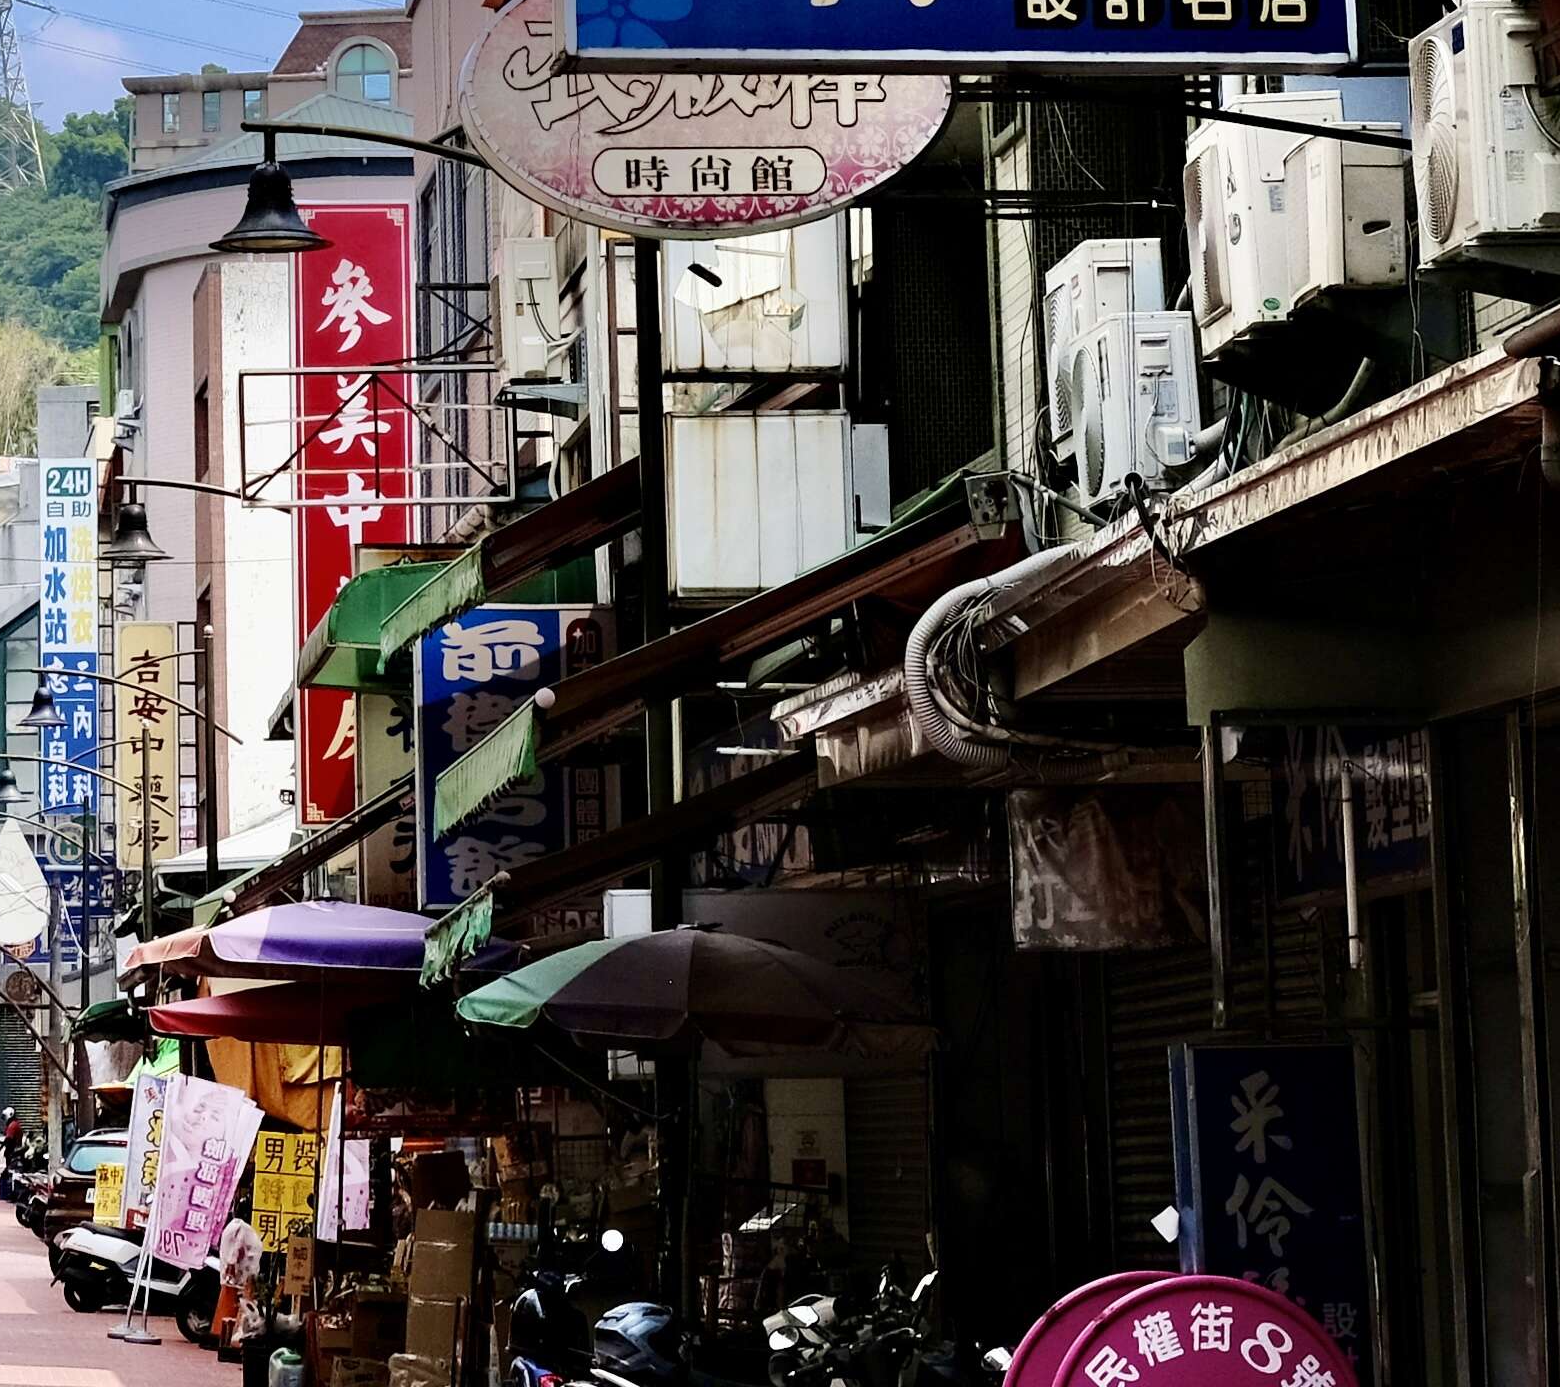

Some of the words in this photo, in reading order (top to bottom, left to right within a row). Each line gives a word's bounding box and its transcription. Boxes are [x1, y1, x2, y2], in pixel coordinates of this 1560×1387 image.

[624, 152, 795, 193] 時尚館
[47, 469, 90, 495] 24H
[46, 500, 92, 518] 自助
[43, 525, 68, 645] 加水站
[71, 526, 94, 645] 洗烘衣
[264, 1137, 317, 1172] 男裝
[1083, 1301, 1336, 1387] 民權街8號
